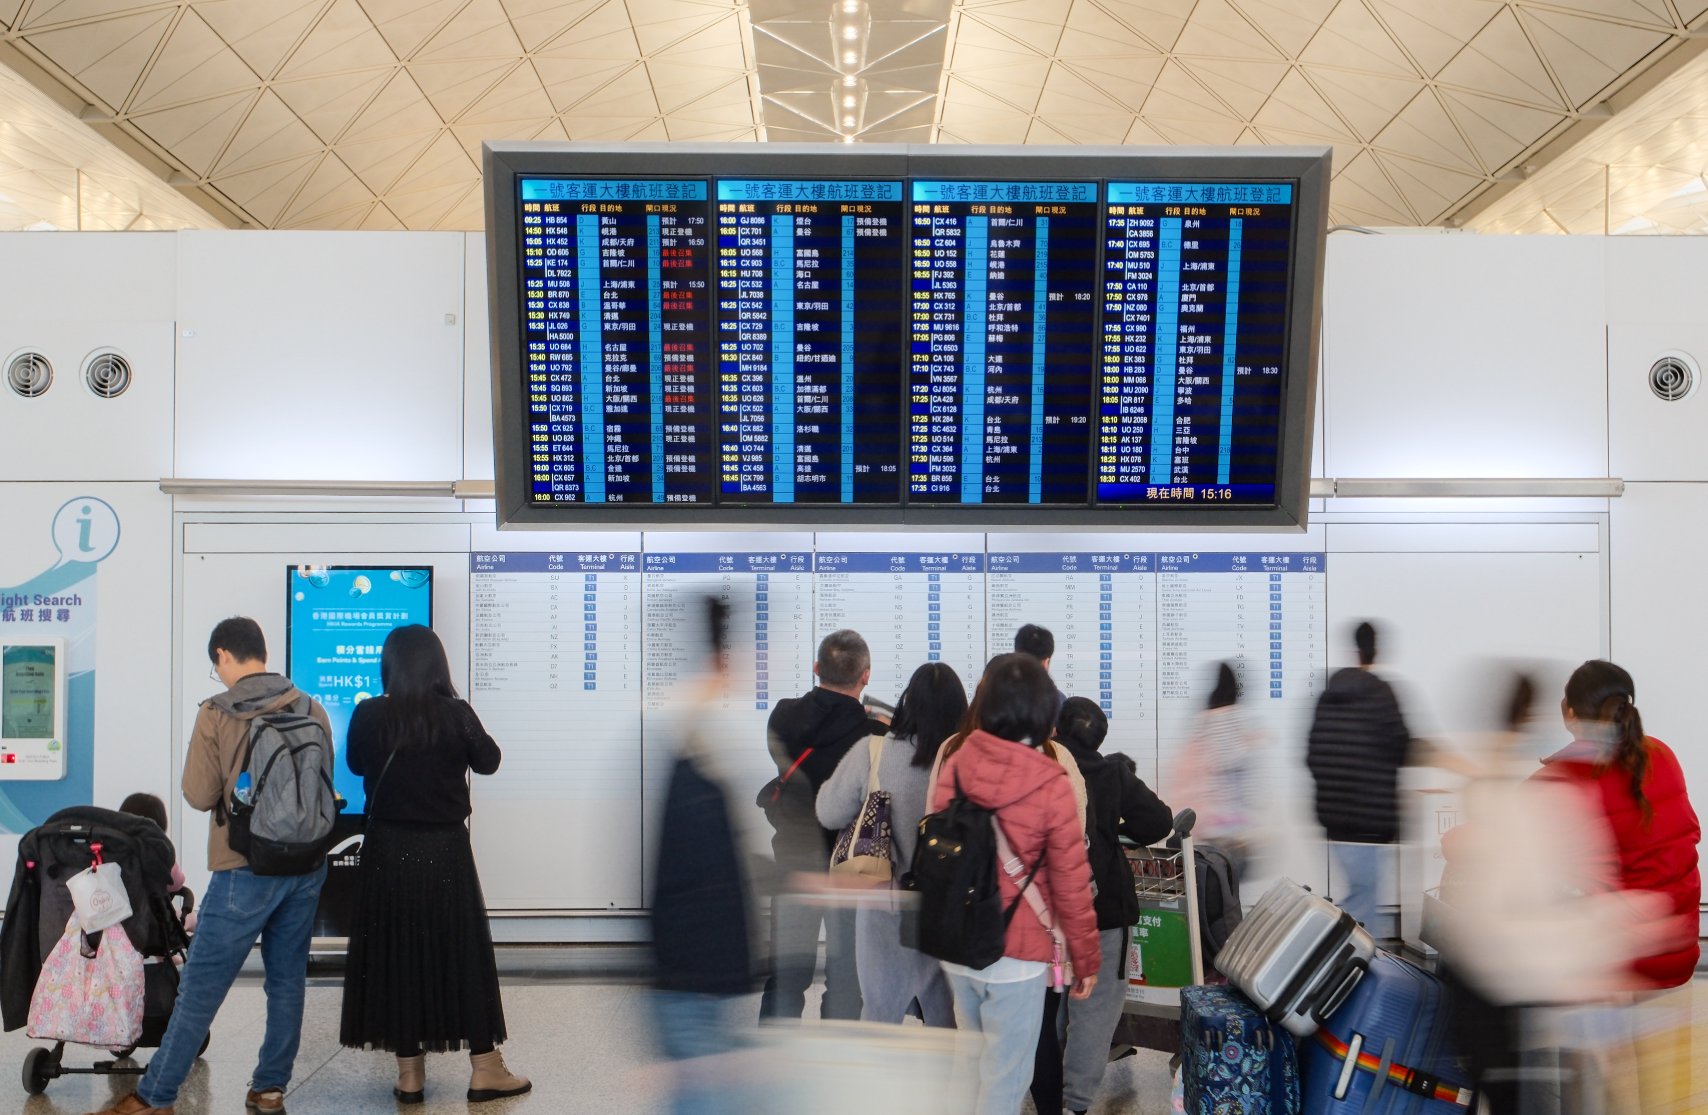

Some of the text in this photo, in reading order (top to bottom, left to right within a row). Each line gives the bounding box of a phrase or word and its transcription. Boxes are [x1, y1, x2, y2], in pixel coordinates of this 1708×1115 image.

[534, 182, 697, 199] 一號客運大樓航班登記
[729, 184, 892, 200] 一號客運大樓航班登記
[924, 185, 1087, 201] 一號客運大樓航班登記
[1120, 186, 1281, 202] 一號客運大樓航班登記
[525, 204, 540, 212] 時間
[544, 204, 559, 212] 航班
[582, 204, 596, 212] 行段
[720, 204, 735, 212] 時間
[915, 205, 930, 213] 時間
[934, 205, 949, 213] 航班
[1109, 207, 1124, 215] 時間
[1128, 207, 1144, 215] 航班
[1166, 207, 1180, 215] 行段
[1184, 207, 1206, 215] 目的地
[602, 238, 634, 246] 成都/天府
[603, 259, 634, 268] 首爾/仁川
[1182, 283, 1214, 291] 北京/首都
[1147, 487, 1231, 499] 現在時間 15:16
[0, 593, 81, 608] ight Search
[2, 608, 70, 622] 航班搜尋
[334, 675, 369, 688] HK$1
